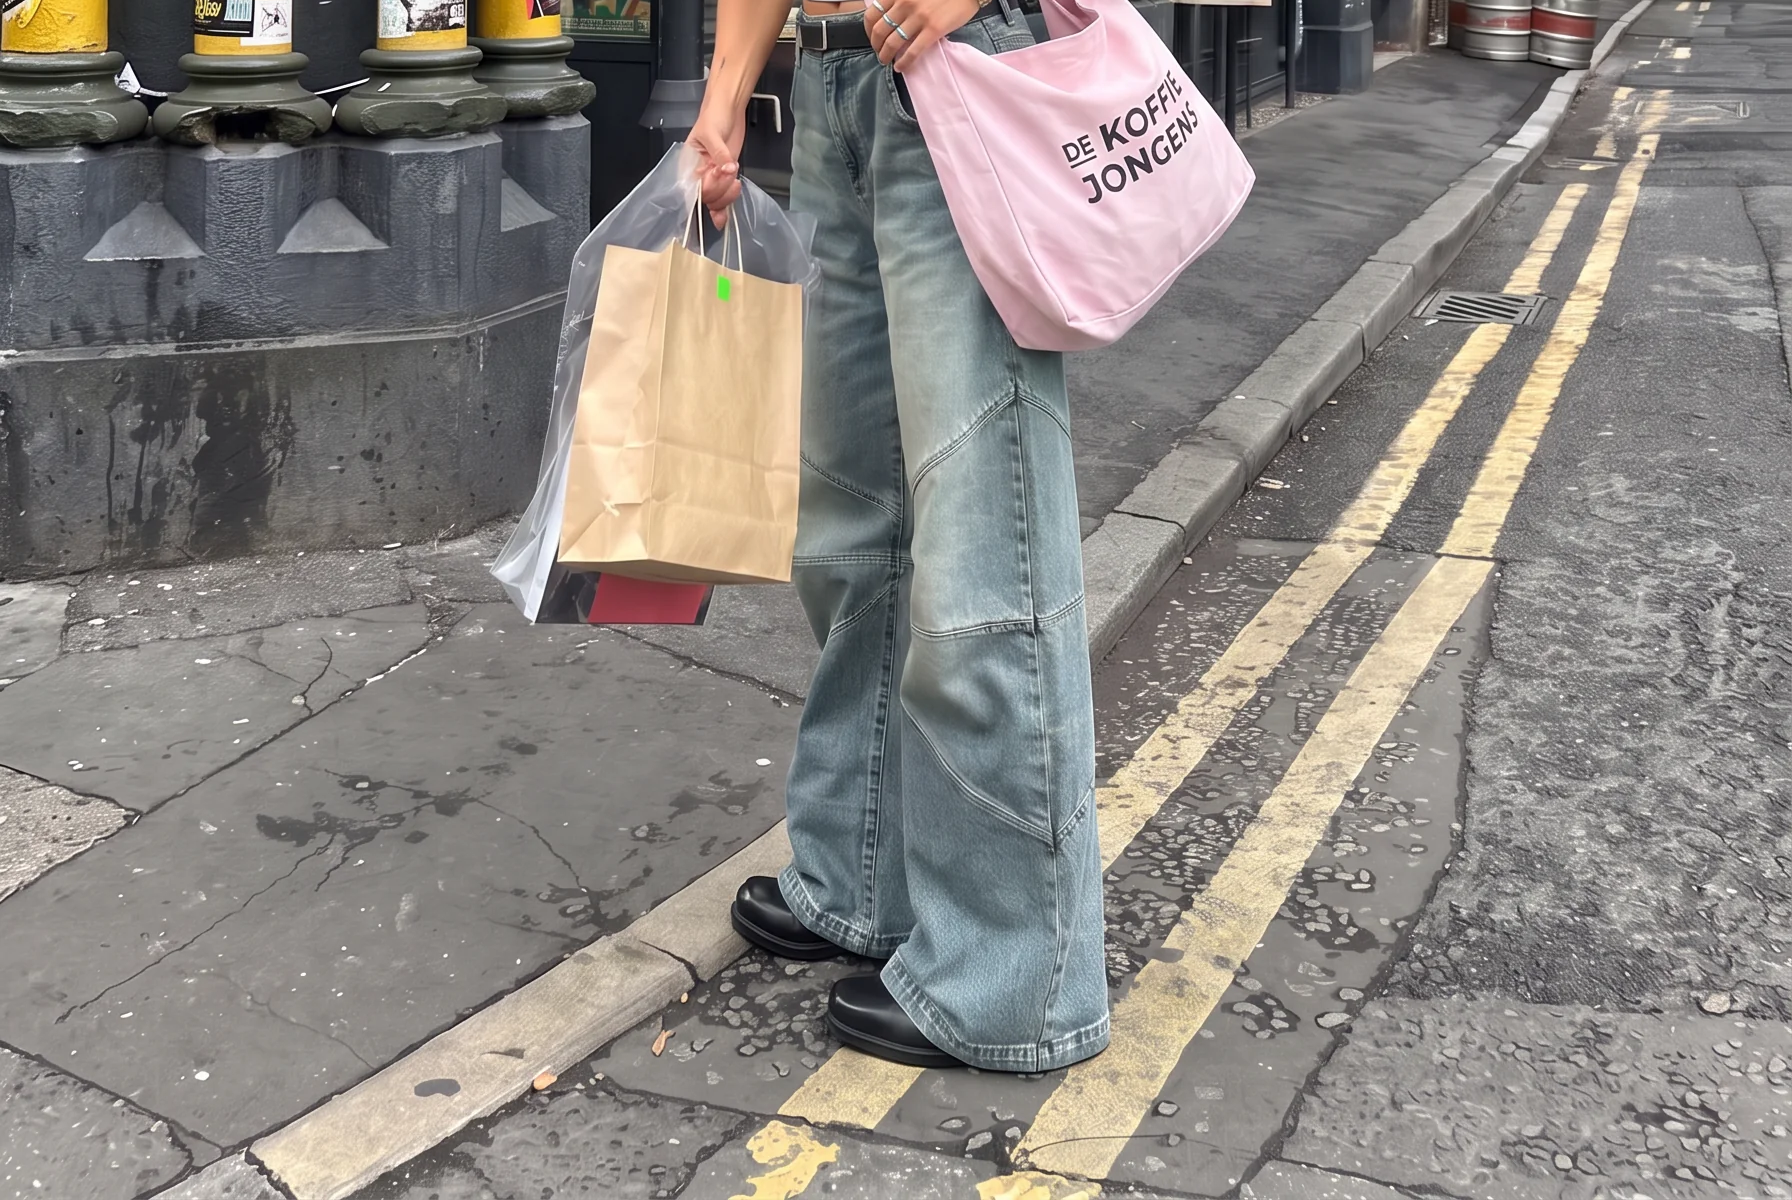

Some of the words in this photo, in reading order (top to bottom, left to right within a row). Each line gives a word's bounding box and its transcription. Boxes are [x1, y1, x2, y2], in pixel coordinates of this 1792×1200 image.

[1061, 133, 1097, 166] DE
[1098, 69, 1183, 153] KOFFIE
[1081, 100, 1199, 205] JONGENS
